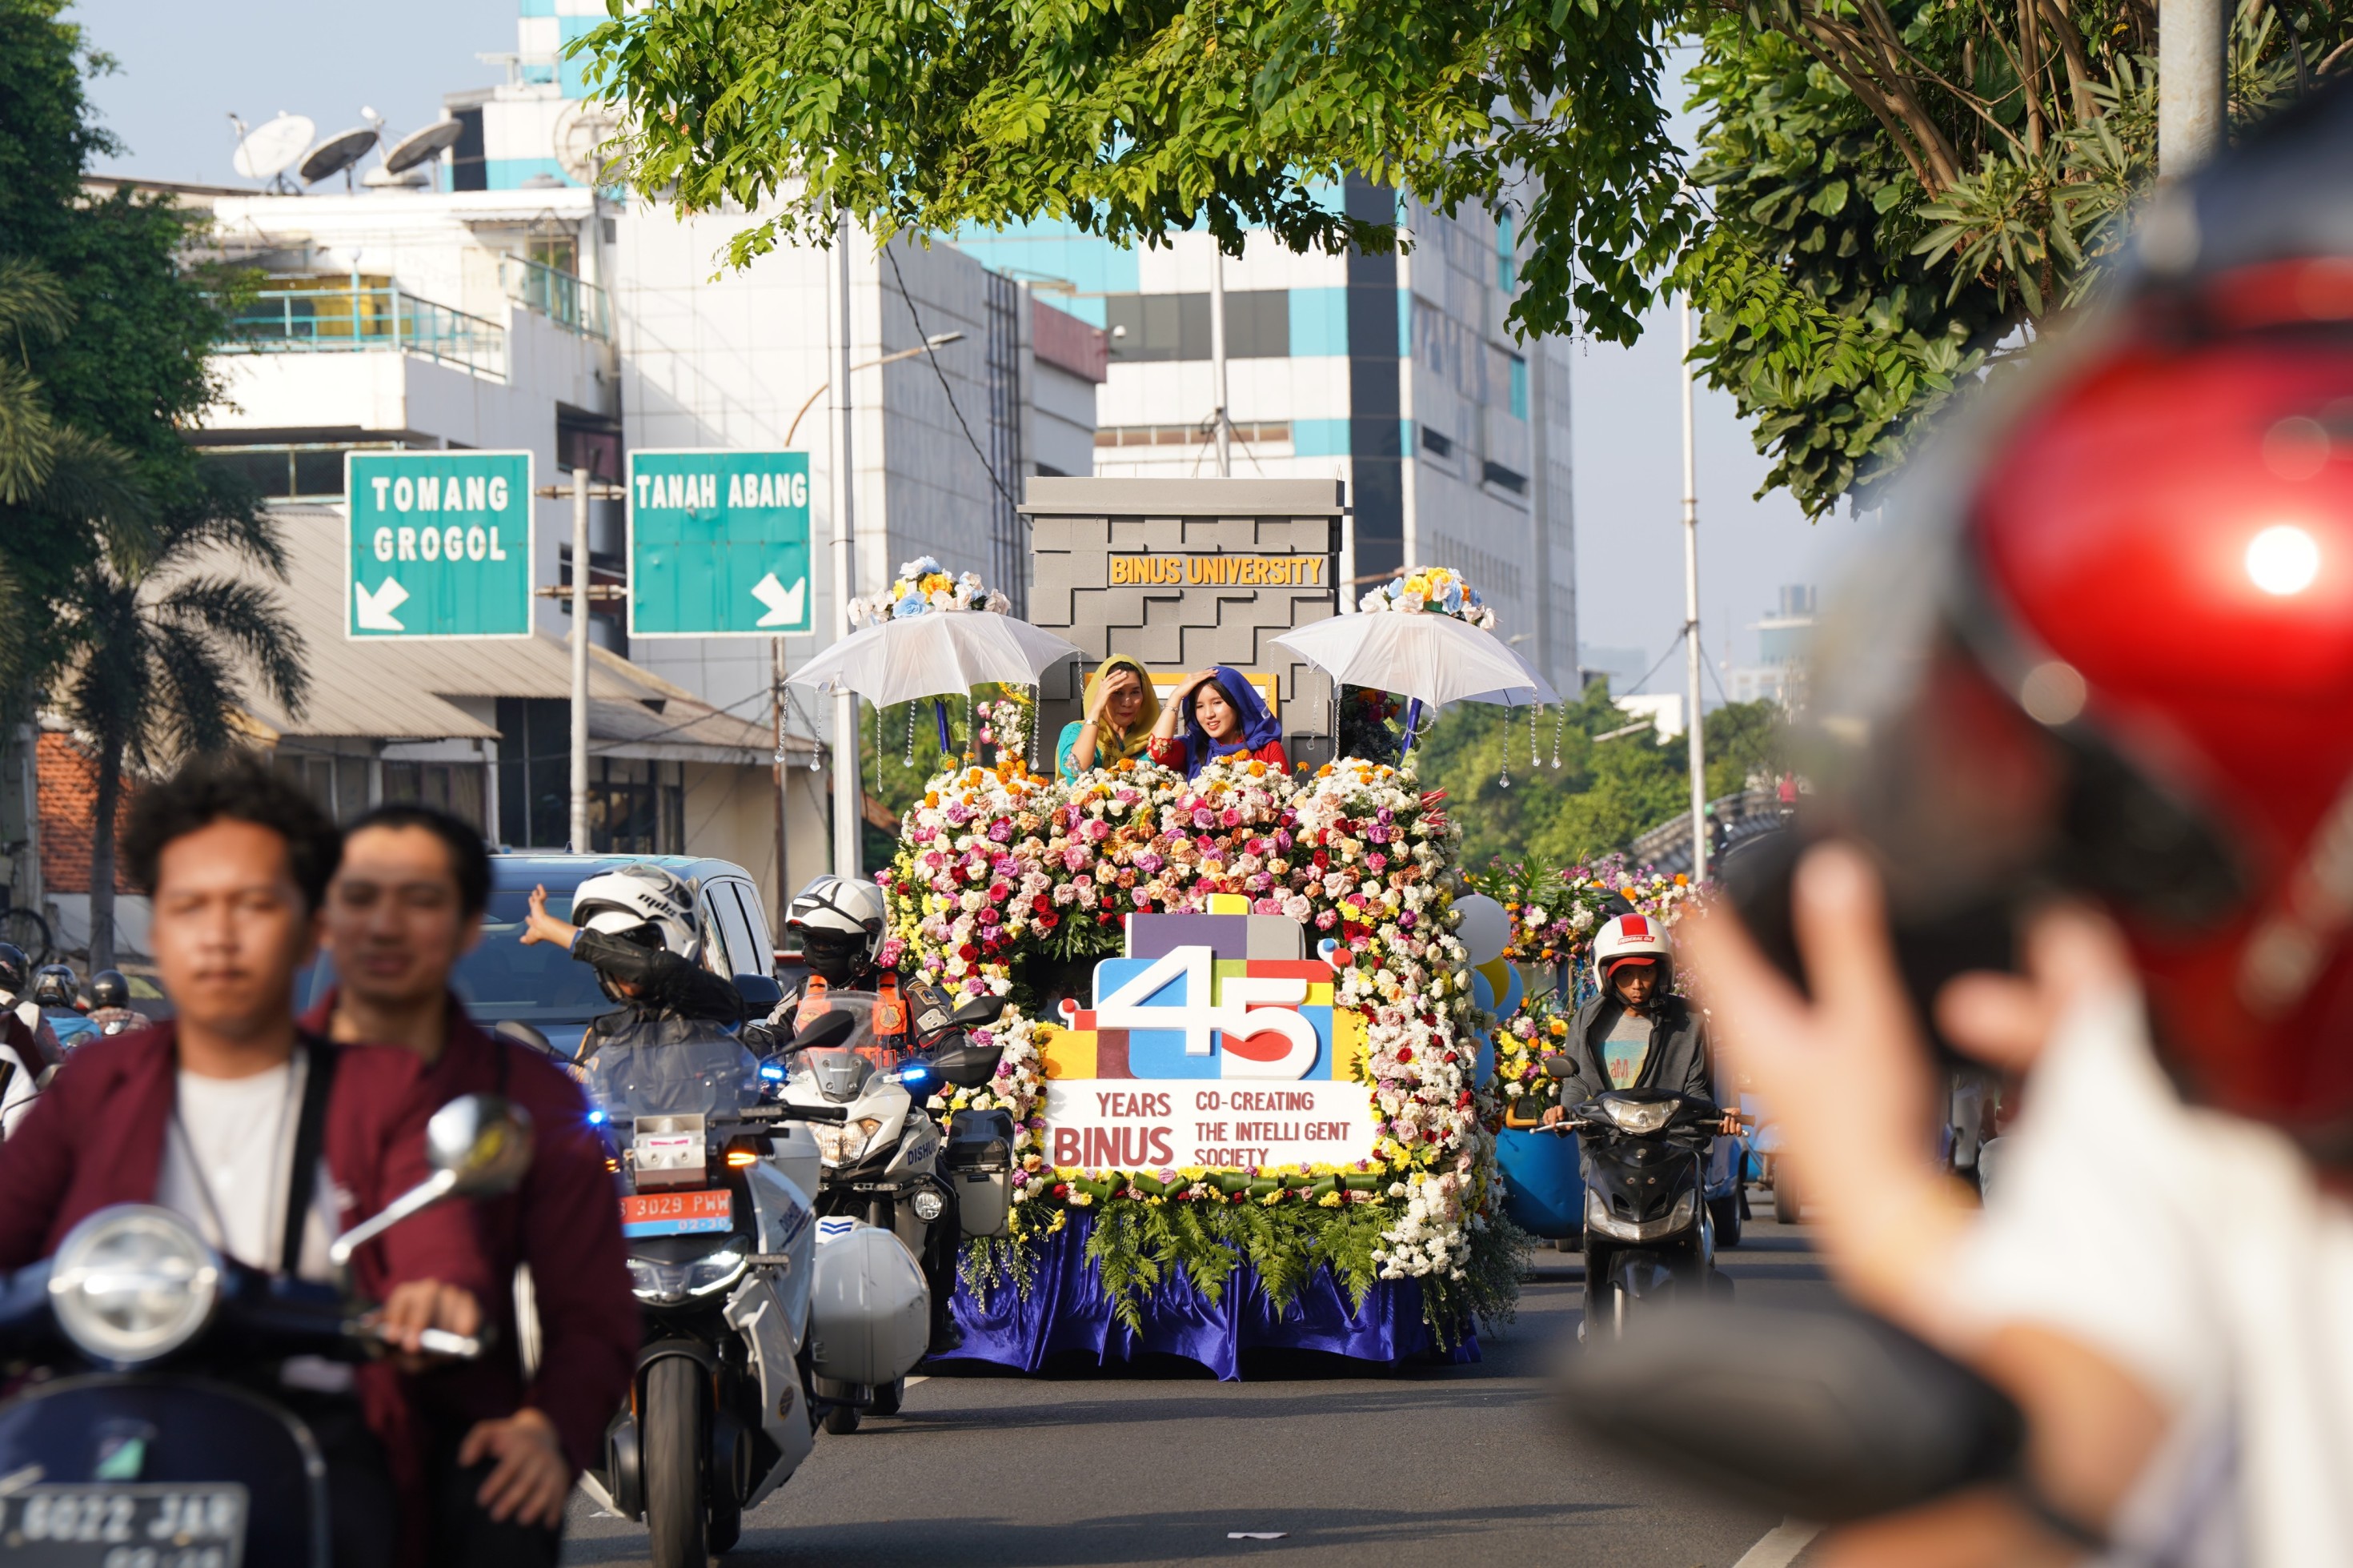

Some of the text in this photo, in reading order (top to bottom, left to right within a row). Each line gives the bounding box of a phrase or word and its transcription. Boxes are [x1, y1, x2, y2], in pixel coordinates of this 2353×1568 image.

[371, 476, 508, 512] TOMANG
[635, 472, 808, 509] TANAH ABANG
[373, 526, 507, 562] GROGOL
[1112, 557, 1324, 585] BINUS UNIVERSITY
[1096, 945, 1317, 1080] 45
[1096, 1092, 1172, 1117] YEARS
[1195, 1091, 1314, 1111] CO-CREATING
[1196, 1122, 1228, 1141] THE
[907, 1137, 937, 1166] DISHUB
[1054, 1127, 1173, 1168] BINUS
[1194, 1148, 1269, 1167] SOCIETY
[637, 1197, 683, 1216] 3029
[694, 1193, 730, 1212] PWW
